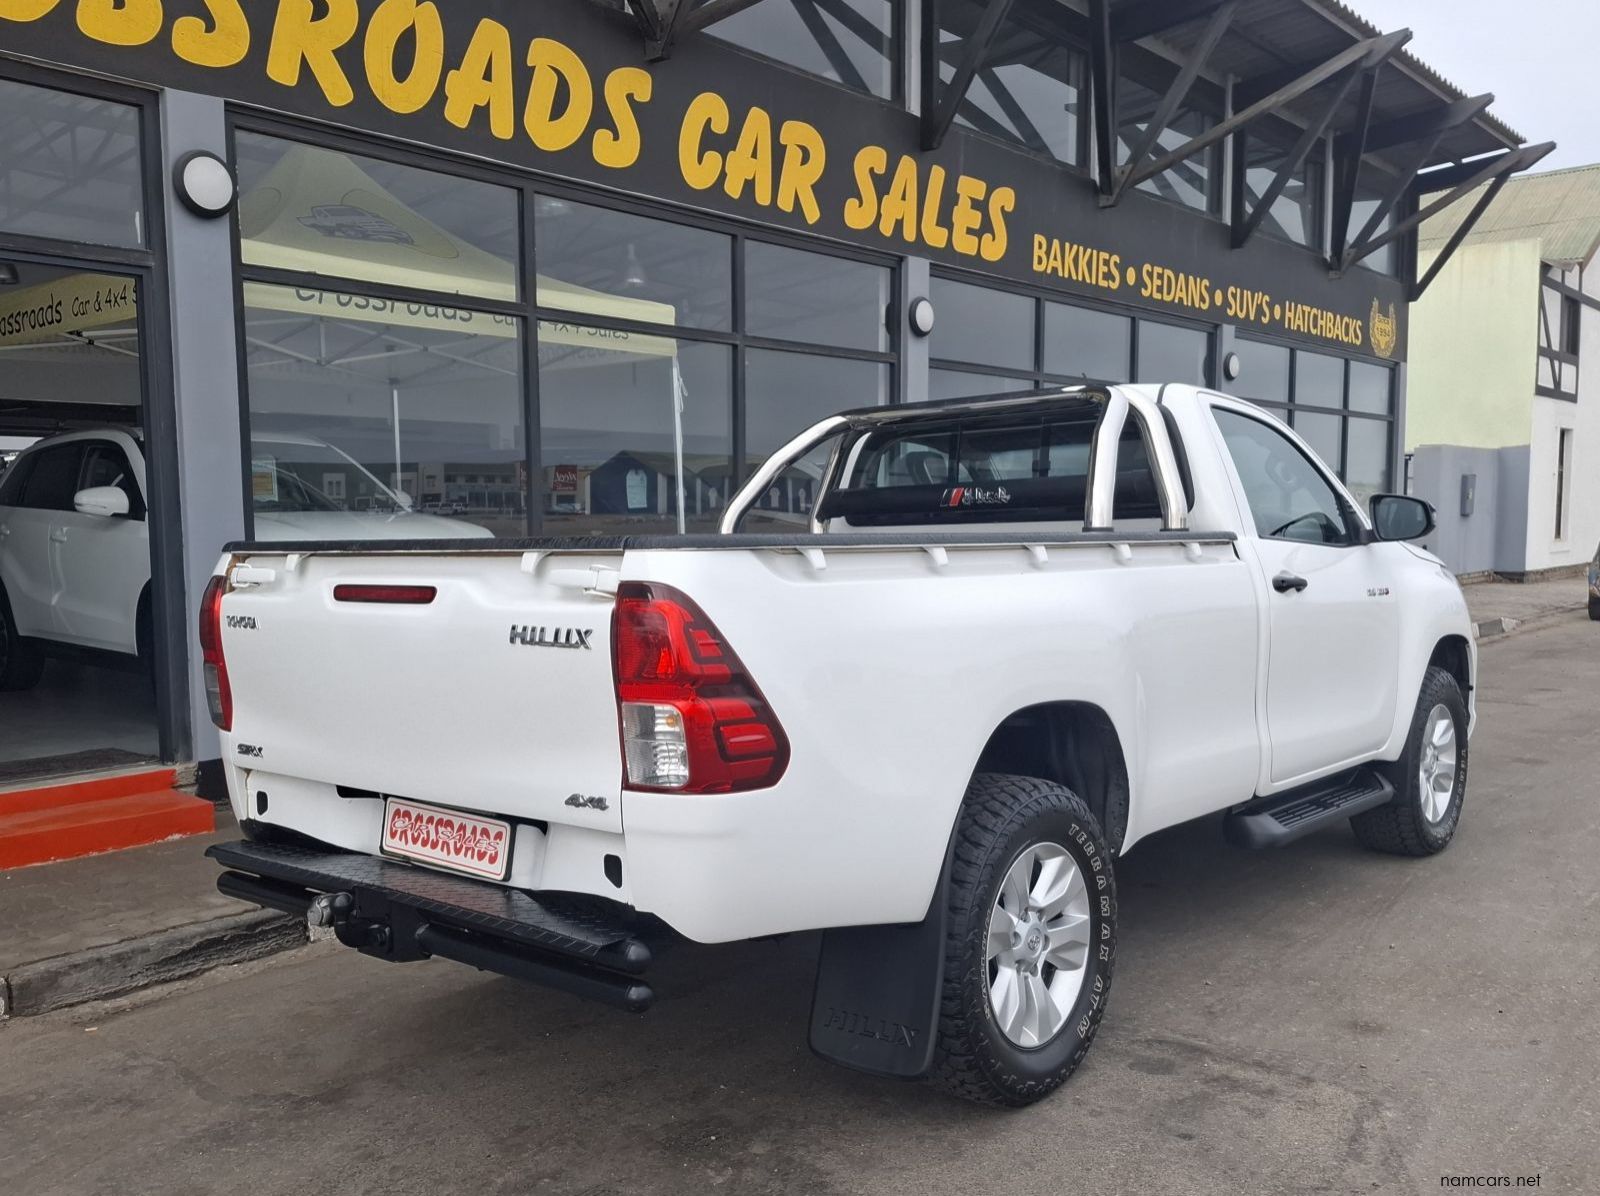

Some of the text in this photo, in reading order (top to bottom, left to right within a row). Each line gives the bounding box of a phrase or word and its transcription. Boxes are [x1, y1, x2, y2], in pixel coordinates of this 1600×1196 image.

[679, 92, 826, 225] CAR
[844, 146, 1015, 262] SALES
[72, 297, 90, 317] Car
[94, 291, 102, 312] &
[105, 284, 127, 309] 4x4
[1032, 233, 1362, 345] BAKKIES SEDANS SUV'S HATCHBACKS
[509, 624, 593, 651] HILUX
[389, 807, 504, 865] CROSSROADS
[1068, 823, 1111, 961] TERRAMAX
